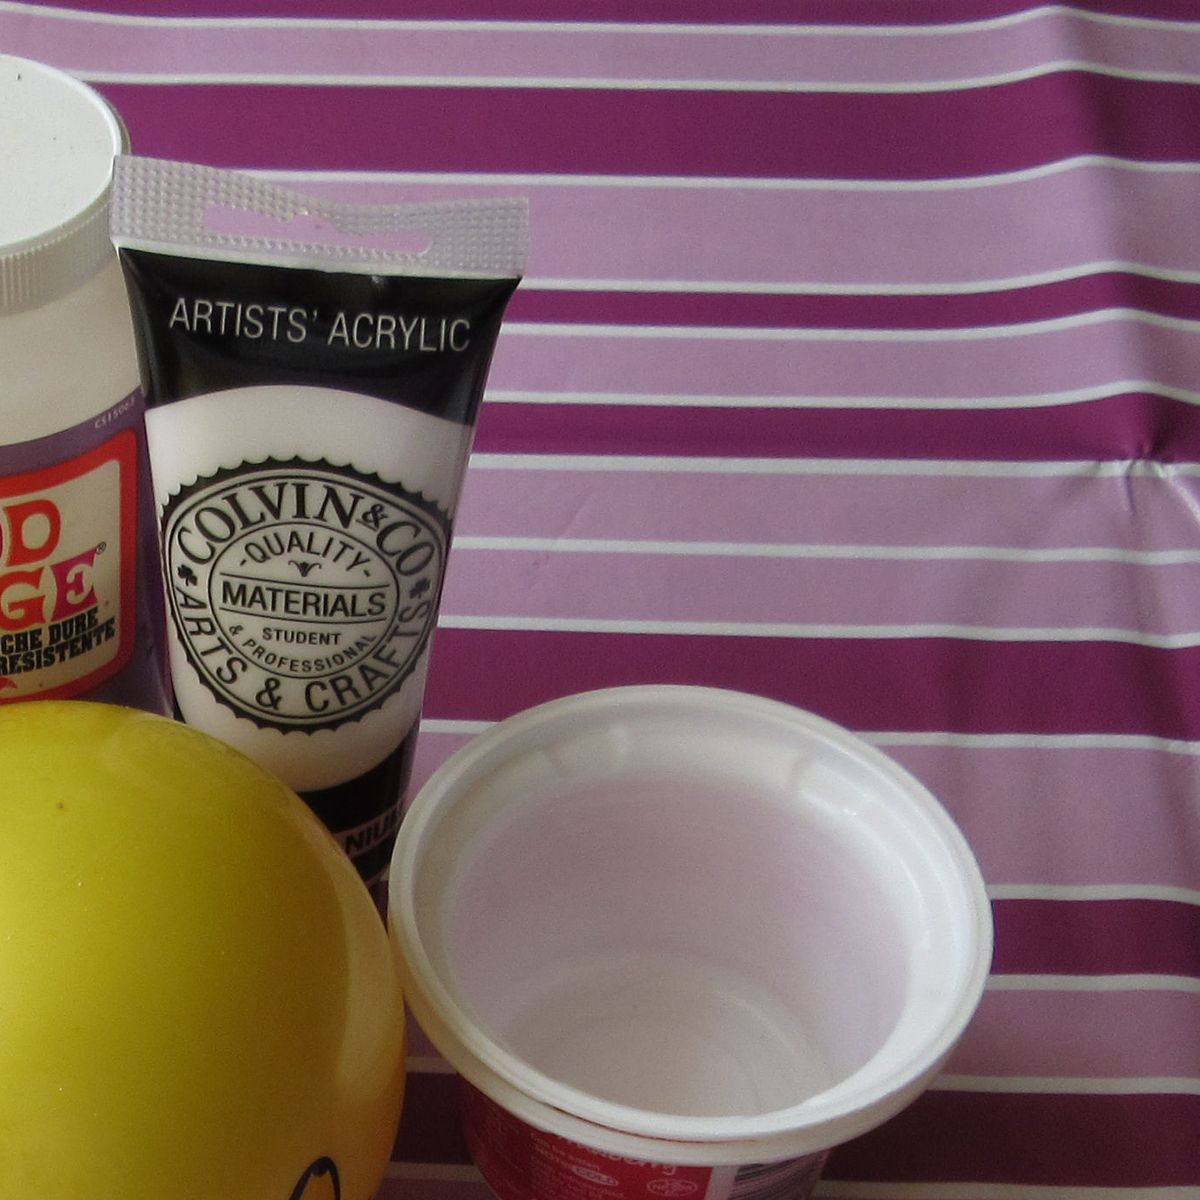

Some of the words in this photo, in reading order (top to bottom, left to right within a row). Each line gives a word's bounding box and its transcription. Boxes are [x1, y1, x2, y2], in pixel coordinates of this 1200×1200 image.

[169, 297, 318, 344] ARTISTS'
[327, 310, 471, 353] ACRYLIC
[222, 579, 388, 620] MATERIALS
[49, 607, 98, 644] DURE
[261, 625, 343, 647] STUDENT
[173, 584, 249, 687] ARTS
[255, 676, 282, 711] &
[304, 600, 431, 715] CRAFTS
[242, 630, 379, 673] PROFESSIONAL
